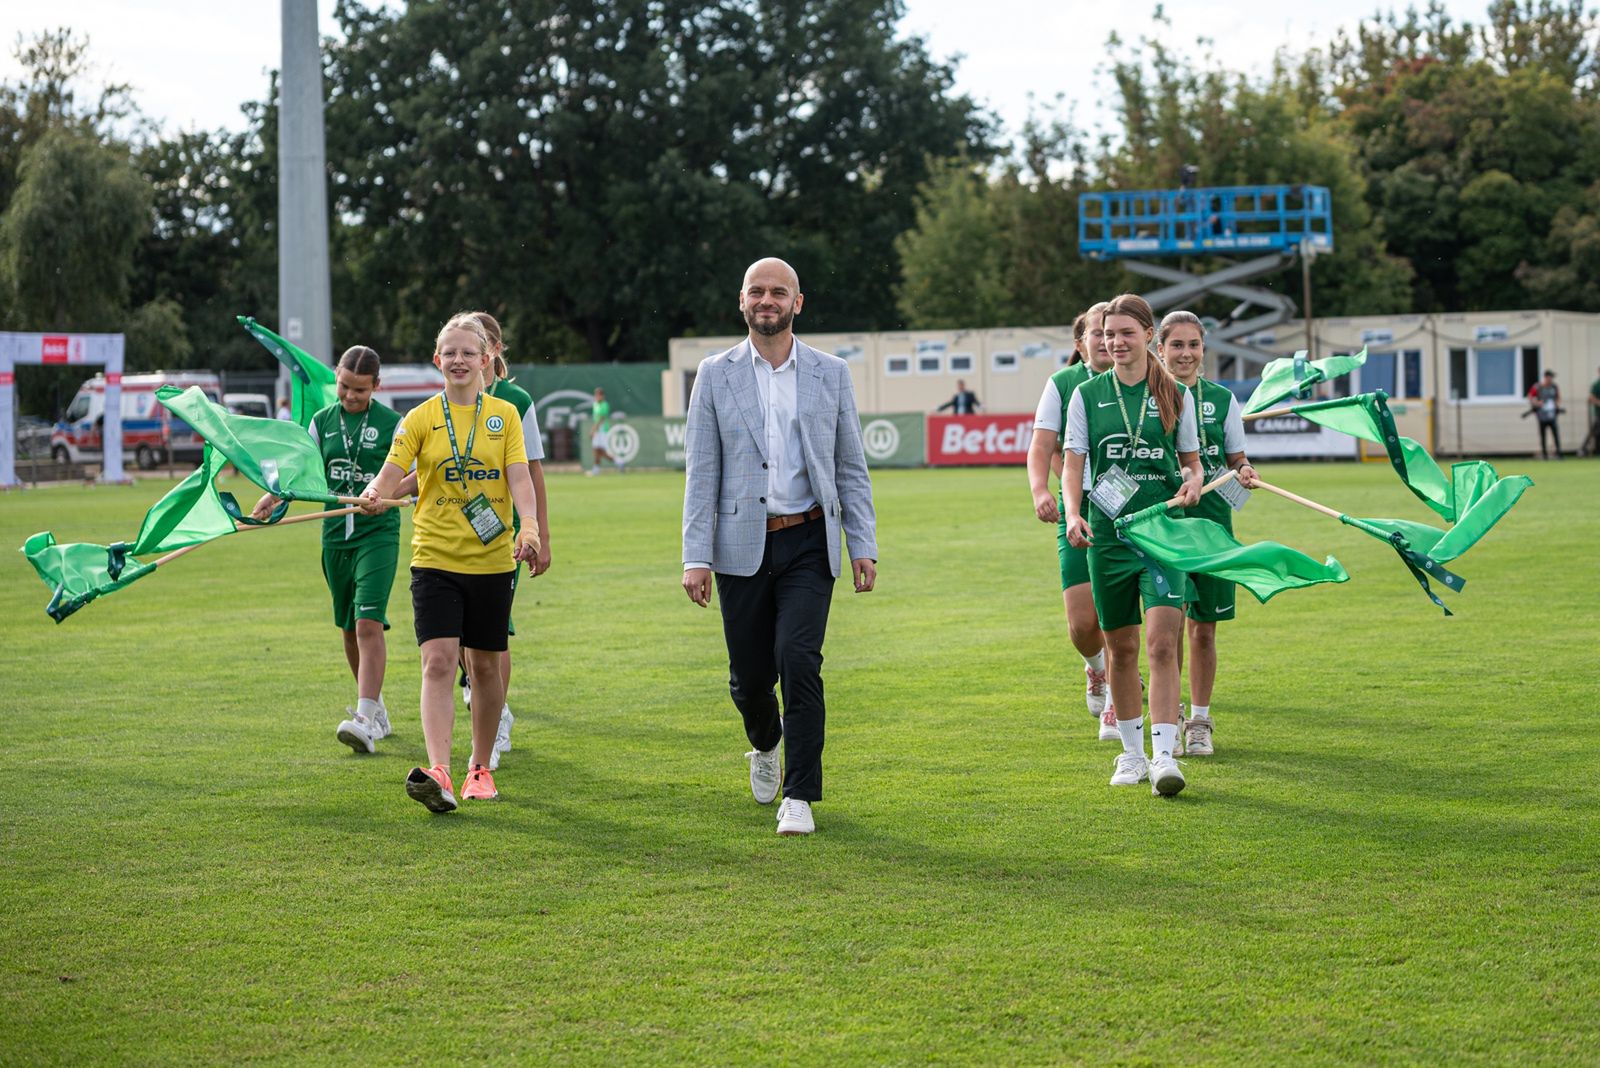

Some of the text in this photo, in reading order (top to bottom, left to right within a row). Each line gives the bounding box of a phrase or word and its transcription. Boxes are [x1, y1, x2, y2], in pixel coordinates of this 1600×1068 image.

[941, 420, 1034, 455] Betcli
[1106, 443, 1164, 459] Enea
[330, 465, 376, 483] Enea
[445, 466, 499, 482] Enea
[1128, 473, 1147, 481] AŃSKI
[448, 497, 470, 505] POZNA
